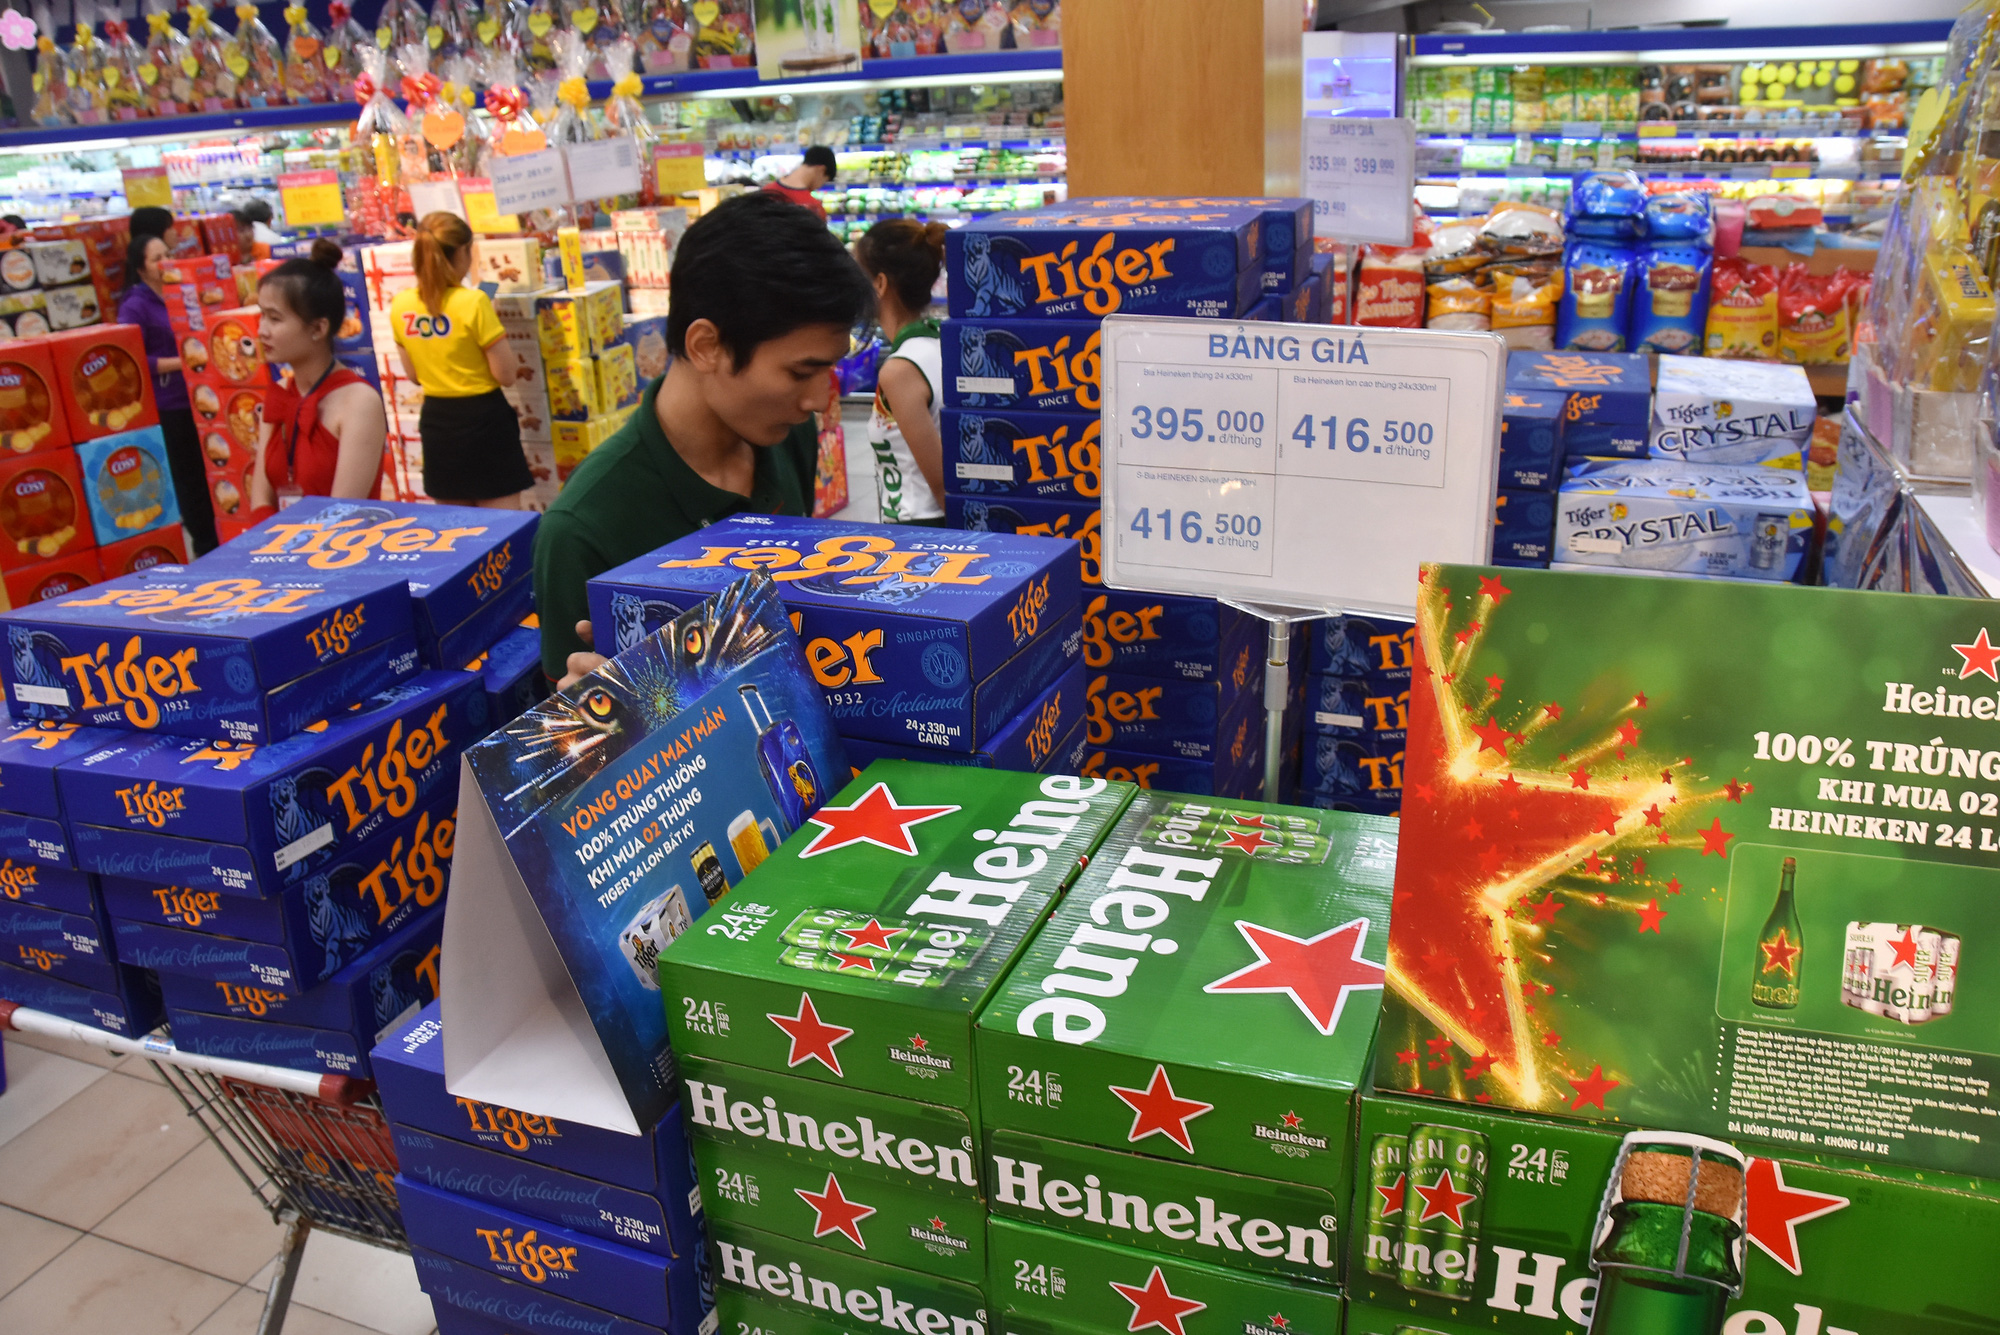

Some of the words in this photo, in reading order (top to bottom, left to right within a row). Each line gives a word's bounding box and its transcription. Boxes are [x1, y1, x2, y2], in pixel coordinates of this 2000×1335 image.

[1020, 232, 1175, 315] Tiger
[1045, 301, 1078, 315] SINCE
[1127, 284, 1158, 298] 1932
[402, 312, 452, 339] ZOO
[1209, 327, 1299, 362] BẢNG
[1312, 332, 1369, 365] GIÁ
[1143, 368, 1155, 377] Bia
[1156, 369, 1191, 379] Heineken
[1192, 370, 1213, 381] thùng
[1214, 372, 1225, 381] 24
[1293, 375, 1307, 385] Bia
[1308, 376, 1344, 387] Heineken
[1358, 380, 1374, 389] cao
[1374, 380, 1397, 392] thùng
[1398, 381, 1437, 392] 24x330ml
[1038, 394, 1069, 408] SINCE
[1667, 402, 1710, 424] Tiger
[1219, 433, 1262, 448] đ/thùng
[1656, 409, 1806, 453] CRYSTAL
[1385, 444, 1430, 460] đ/thùng
[1157, 472, 1198, 483] HEINEKEN
[1566, 506, 1605, 527] Tiger
[249, 517, 489, 570] Tiger
[909, 543, 979, 551] SINCE
[1217, 536, 1259, 551] đ/thùng
[250, 555, 300, 564] SINCE
[378, 553, 421, 562] 1932
[1007, 572, 1050, 642] Tiger
[305, 603, 367, 657] Tiger
[896, 627, 959, 644] SINGAPORE
[1120, 644, 1146, 655] 1932
[61, 635, 202, 729] Tiger
[826, 692, 863, 706] 1932
[872, 685, 973, 718] Acclaimed
[1883, 682, 2000, 721] Heine
[93, 711, 121, 724] SINCE
[163, 700, 190, 712] 1932
[230, 730, 253, 741] CANS
[905, 718, 919, 731] 24
[926, 721, 946, 734] 330
[947, 725, 960, 737] ml
[918, 731, 950, 746] CANS
[1025, 690, 1061, 764] Tiger
[326, 702, 450, 833] Tiger
[1753, 731, 1856, 769] 100%
[1866, 736, 2000, 782] TRÚNG
[561, 789, 618, 839] VÒNG
[615, 753, 663, 799] QUAY
[660, 729, 697, 768] MAY
[115, 781, 187, 827] Tiger
[356, 812, 384, 842] SINCE
[419, 760, 443, 783] 1932
[1817, 777, 1876, 804] KHI
[1882, 783, 1952, 812] MUA
[1959, 791, 1999, 816] 02
[575, 827, 614, 866] 100%
[609, 793, 658, 838] TRÚNG
[587, 857, 616, 890] KHI
[613, 835, 647, 872] MUA
[642, 821, 662, 844] 02
[658, 787, 703, 830] THÙNG
[1769, 807, 1929, 844] HEINEKEN
[1935, 824, 1973, 849] 24
[1979, 827, 2000, 852] L
[598, 877, 631, 909] TIGER
[628, 867, 645, 883] 24
[641, 846, 666, 873] LON
[664, 831, 685, 854] BẤT
[222, 877, 247, 889] CANS
[153, 886, 222, 926] Tiger
[706, 911, 752, 939] 24
[736, 917, 770, 942] PACK
[683, 997, 714, 1024] 24
[403, 1019, 435, 1043] CANS
[685, 1020, 716, 1036] PACK
[889, 1048, 952, 1070] Heineken
[1007, 1065, 1043, 1094] 24
[1048, 1081, 1062, 1093] 330
[1008, 1090, 1043, 1106] PACK
[1049, 1092, 1062, 1103] ML
[400, 1135, 434, 1149] PARIS
[478, 1134, 499, 1143] SINCE
[533, 1137, 553, 1146] 1932
[1255, 1125, 1327, 1149] Heineken
[1799, 1131, 1816, 1143] BIA
[1824, 1134, 1858, 1150] KHÔNG
[1876, 1143, 1889, 1155] XE
[1508, 1144, 1548, 1172] 24
[1553, 1160, 1569, 1171] 330
[715, 1168, 744, 1193] 24
[1507, 1168, 1545, 1184] PACK
[1553, 1169, 1567, 1180] ML
[415, 1165, 485, 1194] World
[489, 1176, 609, 1209] Acclaimed
[718, 1188, 746, 1204] PACK
[600, 1210, 614, 1223] 24
[622, 1217, 644, 1232] 330
[645, 1222, 661, 1236] ml
[614, 1224, 651, 1244] CANS
[910, 1227, 968, 1249] Heineken
[476, 1227, 579, 1284] Tiger
[1014, 1259, 1048, 1286] 24
[1015, 1280, 1048, 1296] PACK
